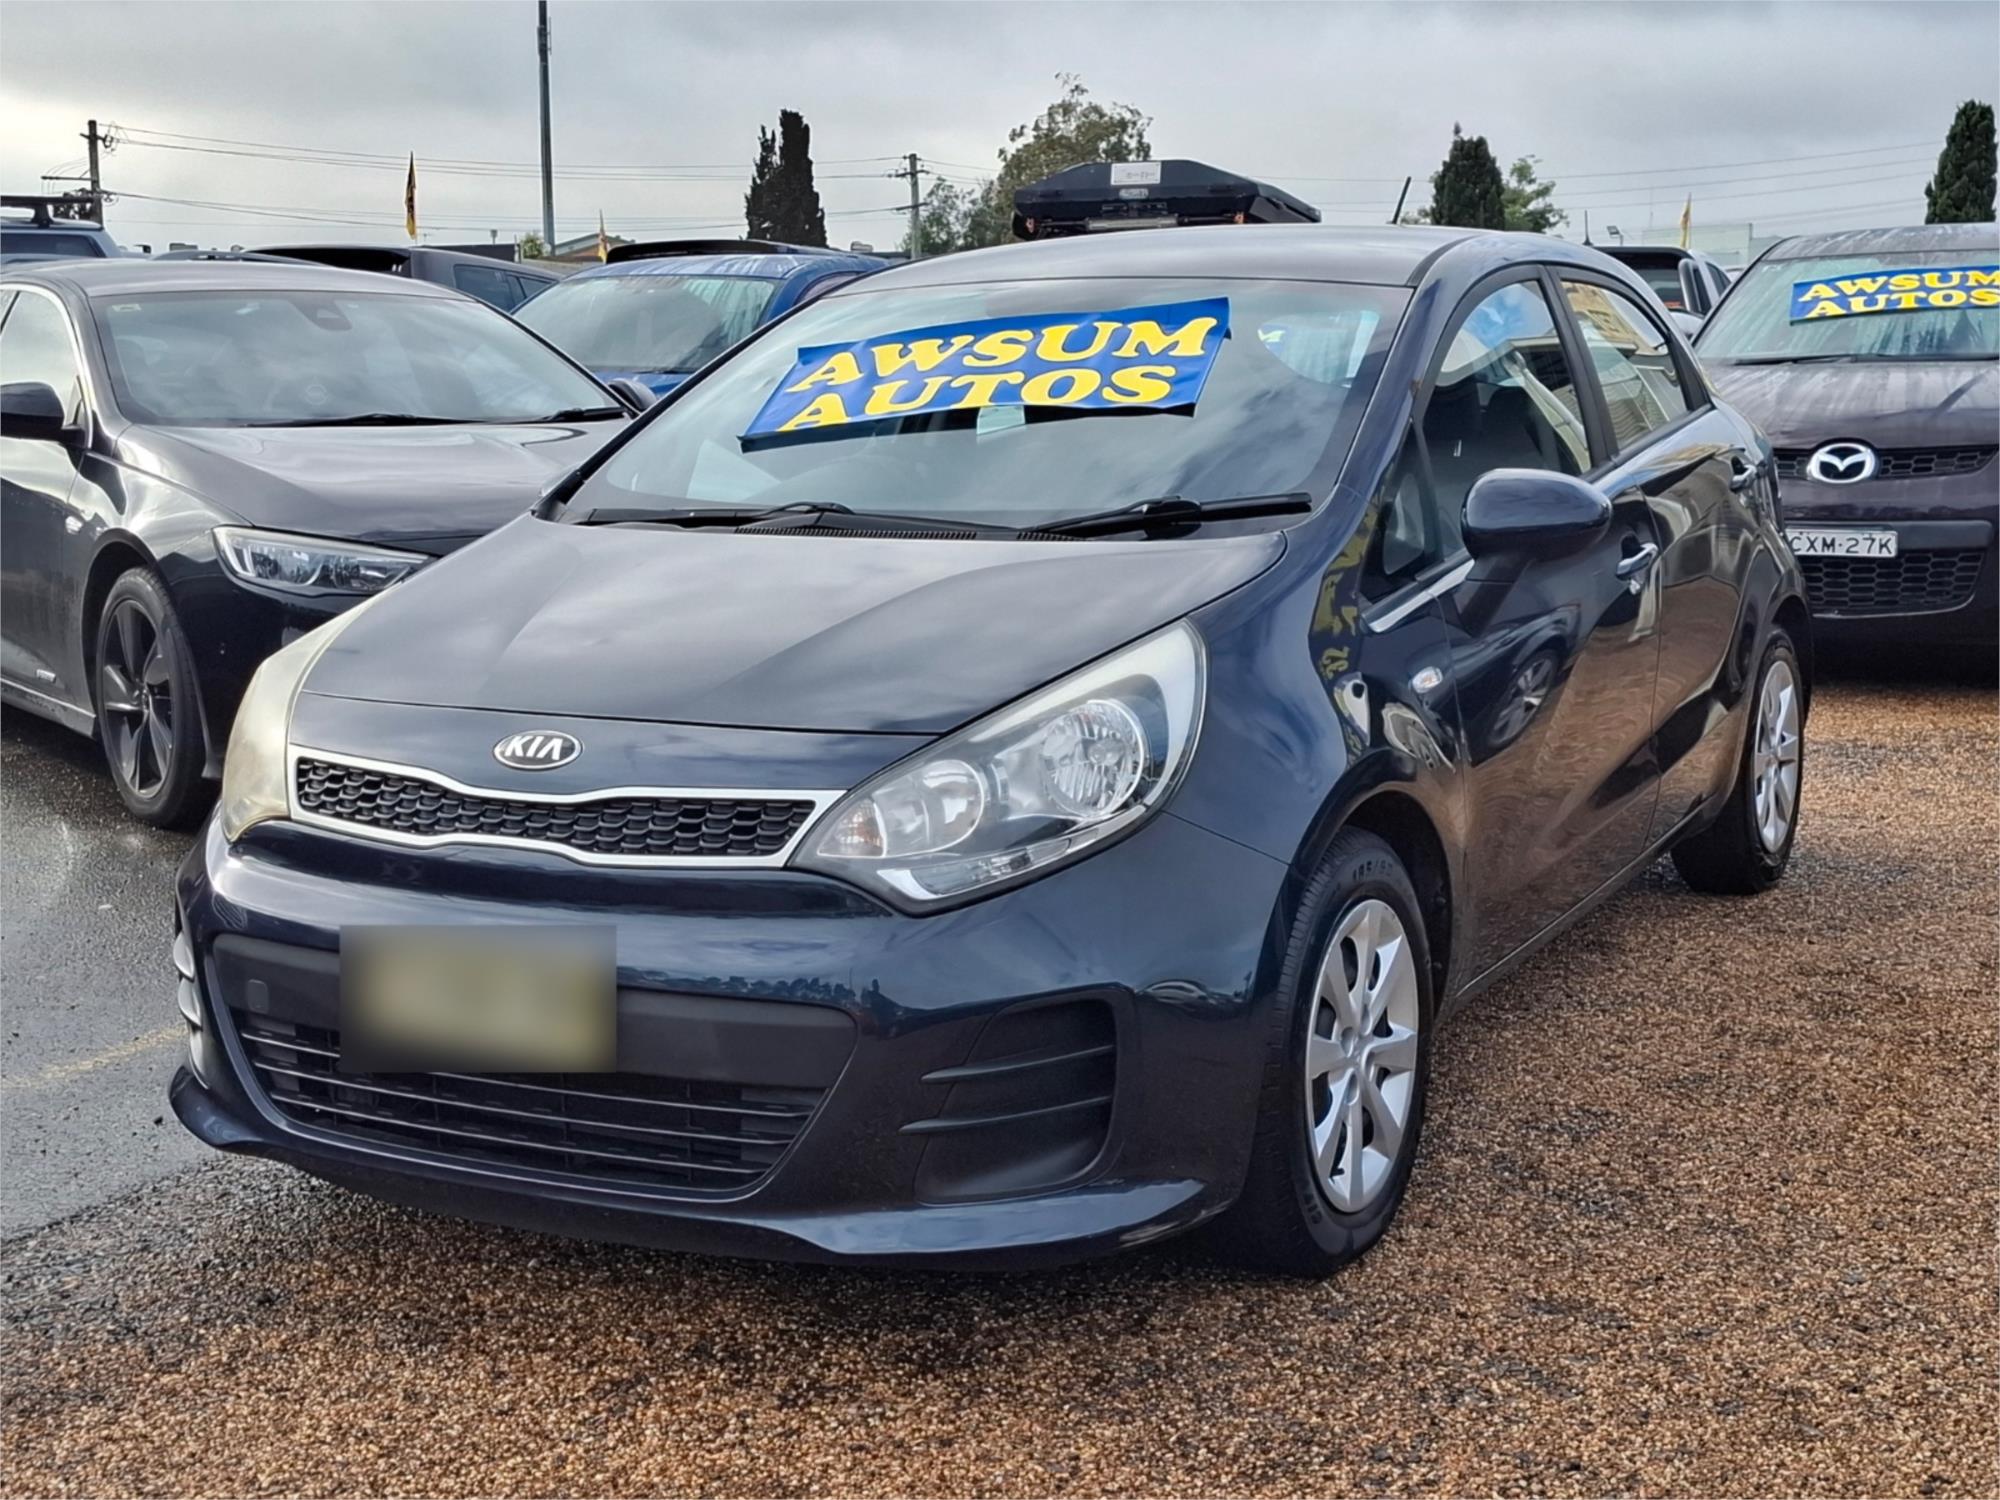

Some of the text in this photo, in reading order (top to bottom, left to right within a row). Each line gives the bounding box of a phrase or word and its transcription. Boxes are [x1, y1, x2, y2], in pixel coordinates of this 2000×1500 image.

[1798, 270, 1999, 302] AWSUM
[1805, 288, 1999, 318] AUTOS
[786, 316, 1218, 393] AWSUM
[775, 365, 1178, 432] AUTOS
[503, 735, 564, 761] KIA
